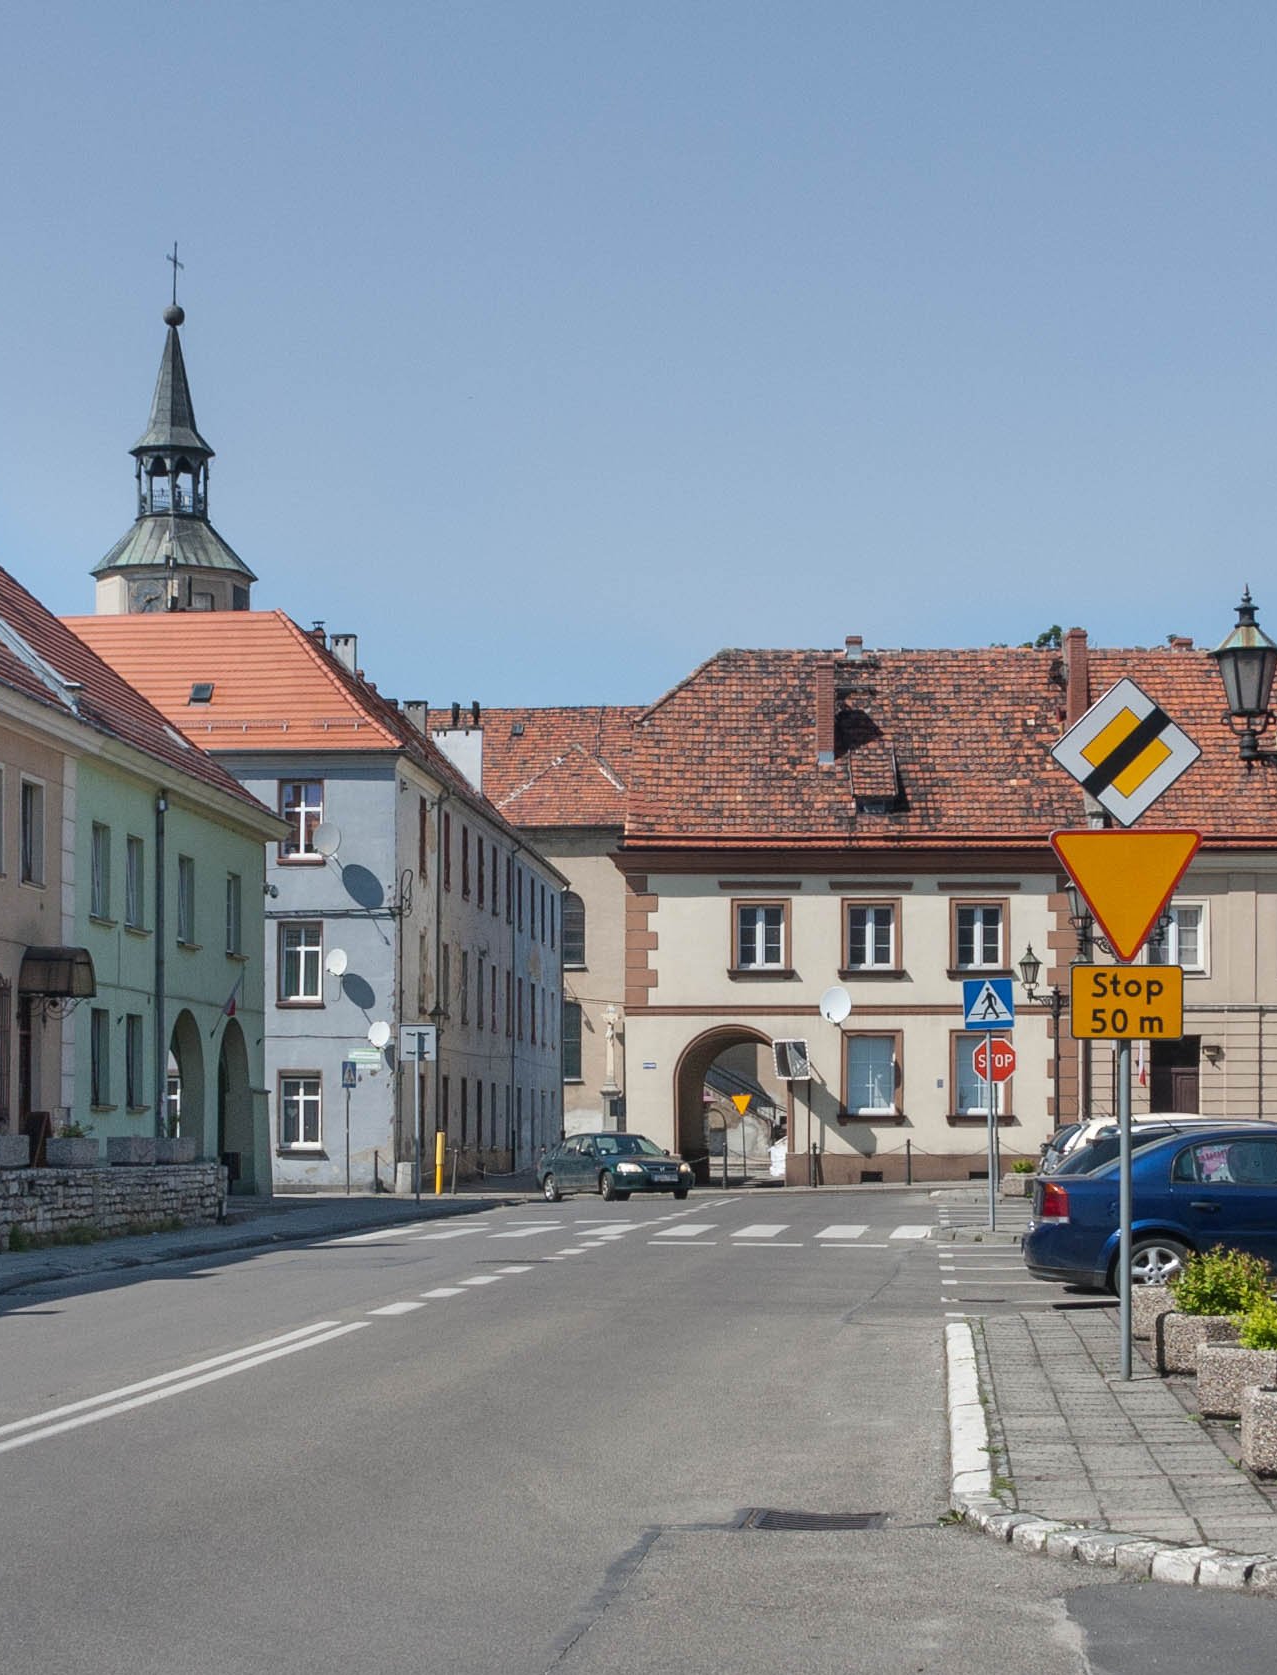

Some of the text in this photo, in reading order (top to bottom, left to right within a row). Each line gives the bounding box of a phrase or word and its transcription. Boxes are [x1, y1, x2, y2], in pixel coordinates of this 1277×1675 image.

[1091, 972, 1163, 1005] Stop
[1091, 1008, 1163, 1033] 50 m
